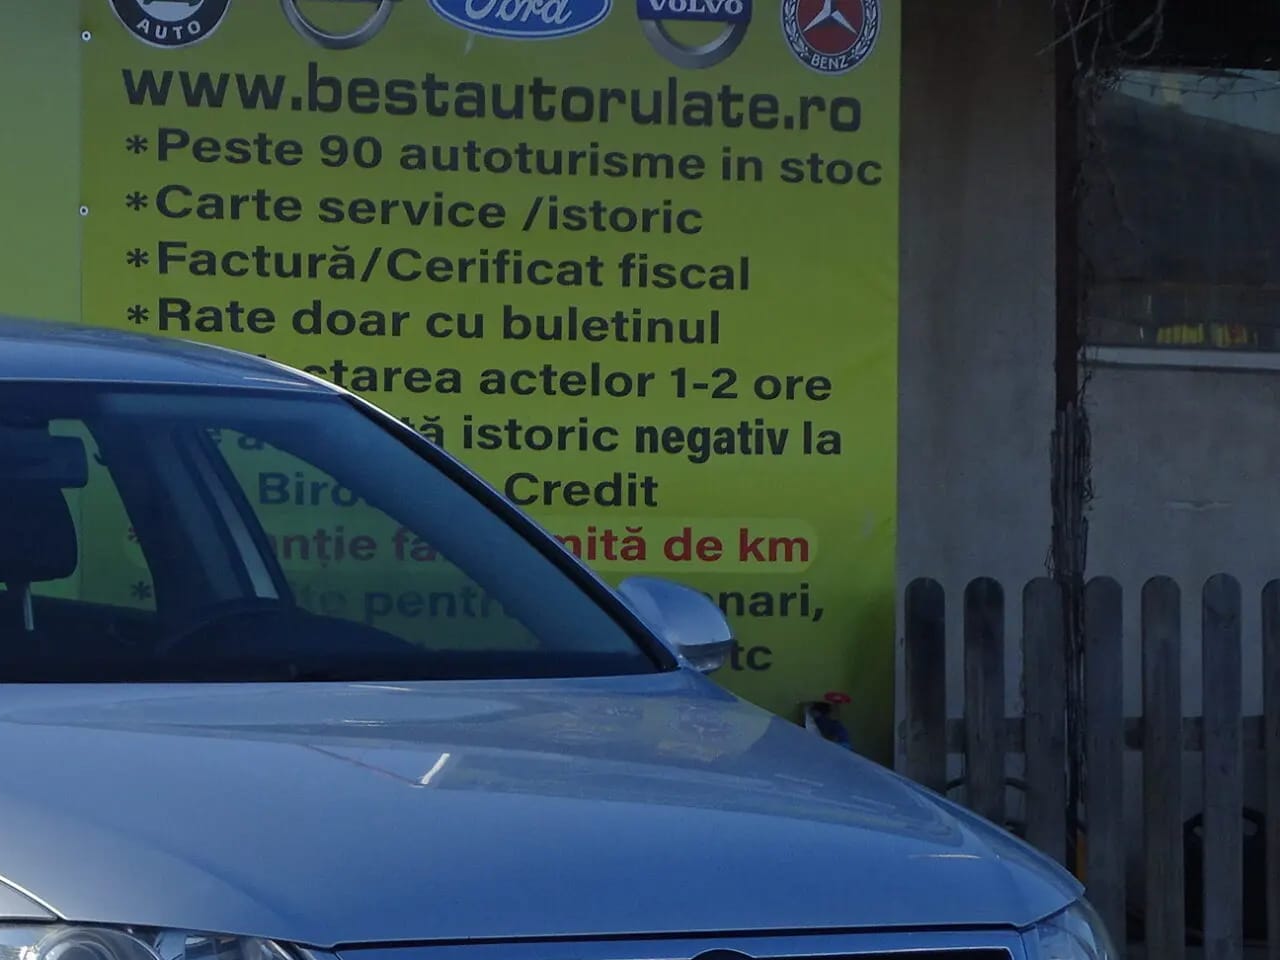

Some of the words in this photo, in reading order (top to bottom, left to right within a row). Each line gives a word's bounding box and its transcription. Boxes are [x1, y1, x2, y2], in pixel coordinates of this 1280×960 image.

[651, 0, 744, 14] VOLVO
[136, 19, 202, 40] AUTO
[810, 54, 849, 70] BENZ
[121, 62, 862, 132] www.bestautorulate.ro
[320, 134, 383, 169] 90
[399, 139, 705, 180] autoturisme
[721, 146, 763, 181] in
[780, 152, 882, 185] stoc
[318, 191, 506, 228] service
[618, 252, 749, 290] fiscal
[291, 300, 410, 337] doar
[426, 311, 484, 339] cu
[503, 304, 719, 344] buletinul
[479, 362, 655, 398] actelor
[670, 367, 738, 399] 1-2
[753, 374, 832, 401] ore
[463, 415, 619, 452] istoric
[635, 418, 789, 463] negativ
[803, 421, 842, 455] la
[504, 472, 658, 507] Credit
[663, 527, 723, 562] de
[738, 527, 809, 562] km
